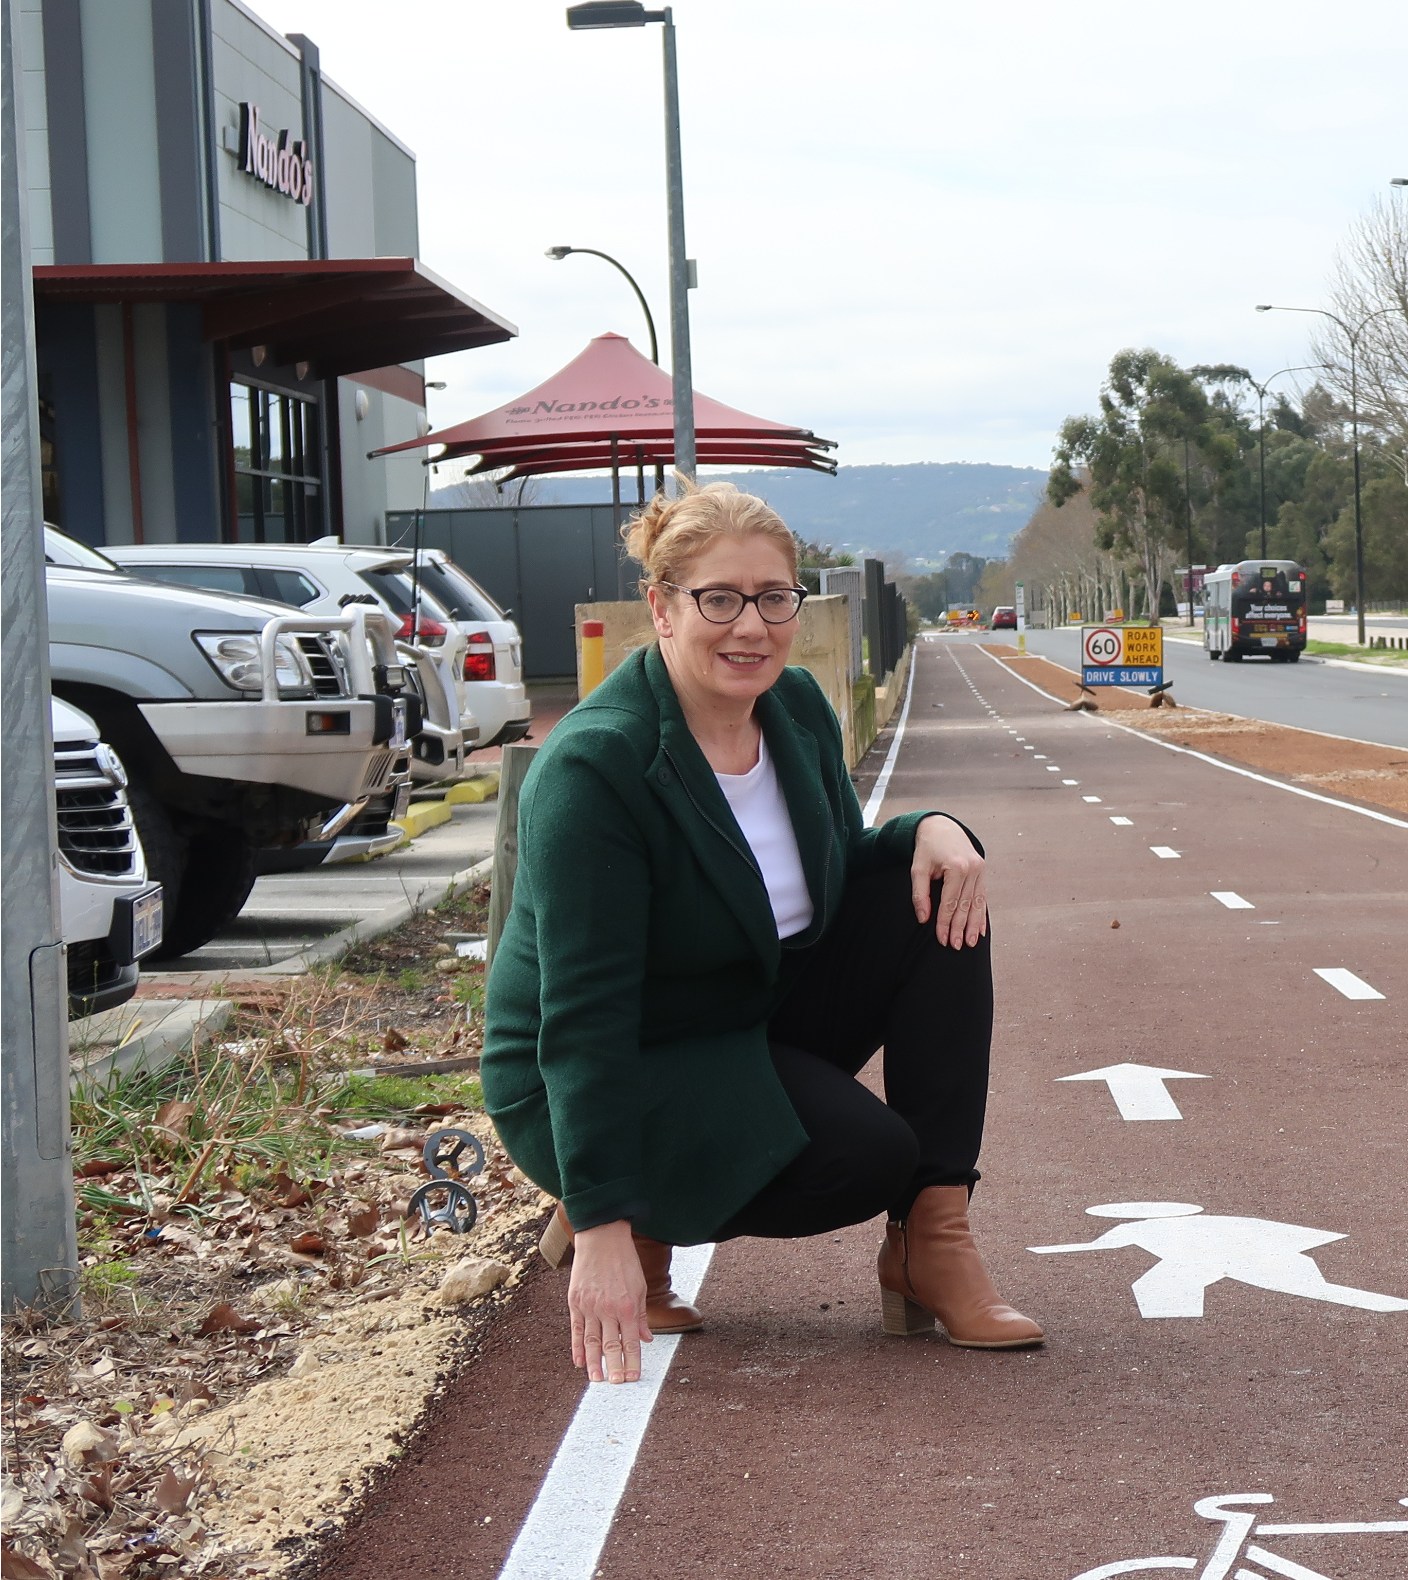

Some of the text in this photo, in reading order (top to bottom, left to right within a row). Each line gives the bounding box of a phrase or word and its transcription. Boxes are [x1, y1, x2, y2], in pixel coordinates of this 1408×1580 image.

[245, 101, 312, 207] Nando's
[531, 394, 660, 415] Nando's
[1127, 631, 1156, 641] ROAD
[1092, 638, 1115, 655] 60
[1127, 643, 1156, 652] WORK
[1124, 655, 1160, 664] AHEAD
[1086, 671, 1159, 682] DRIVE SLOWLY
